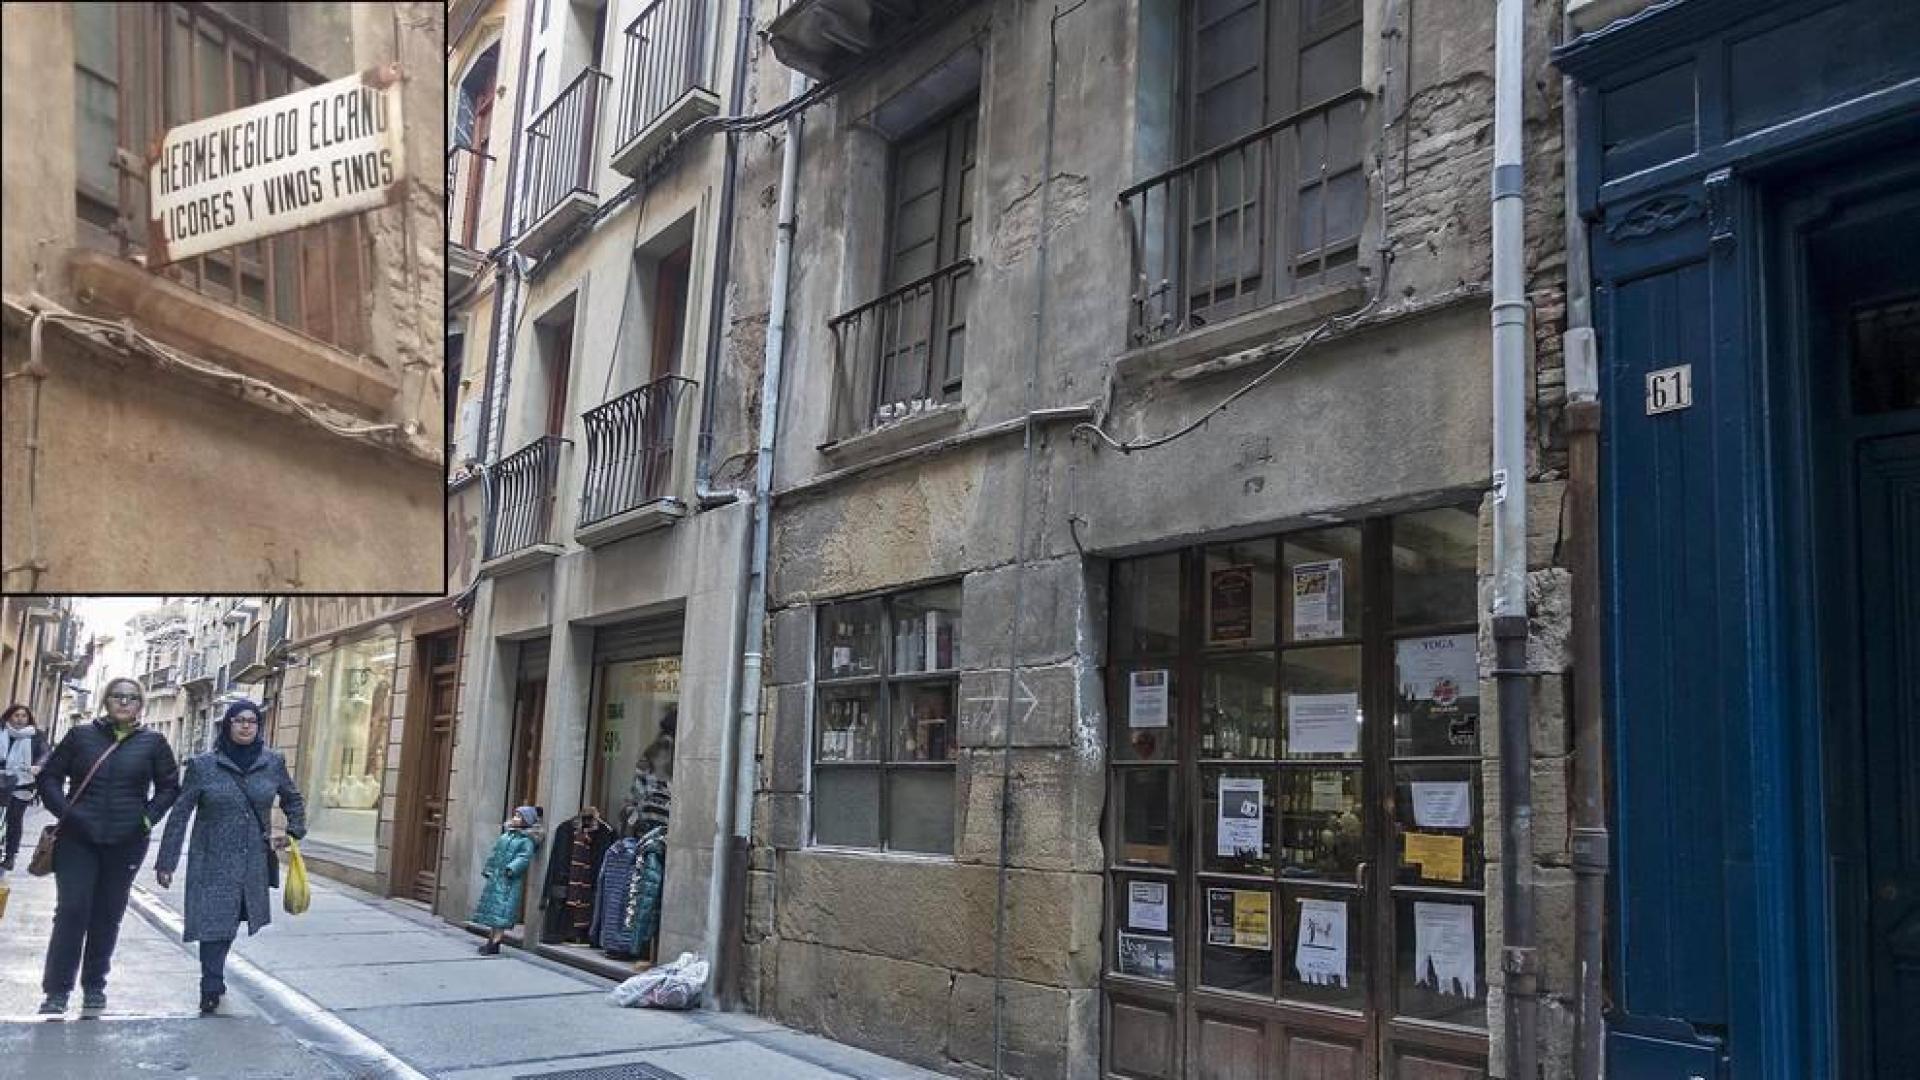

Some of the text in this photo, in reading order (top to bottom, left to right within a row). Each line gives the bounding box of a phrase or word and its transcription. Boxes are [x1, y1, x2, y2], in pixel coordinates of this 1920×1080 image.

[160, 108, 299, 196] HERMENEGILDO
[242, 184, 255, 221] Y
[263, 166, 323, 216] VINOS
[331, 149, 393, 198] FINOS
[1653, 371, 1681, 408] 61
